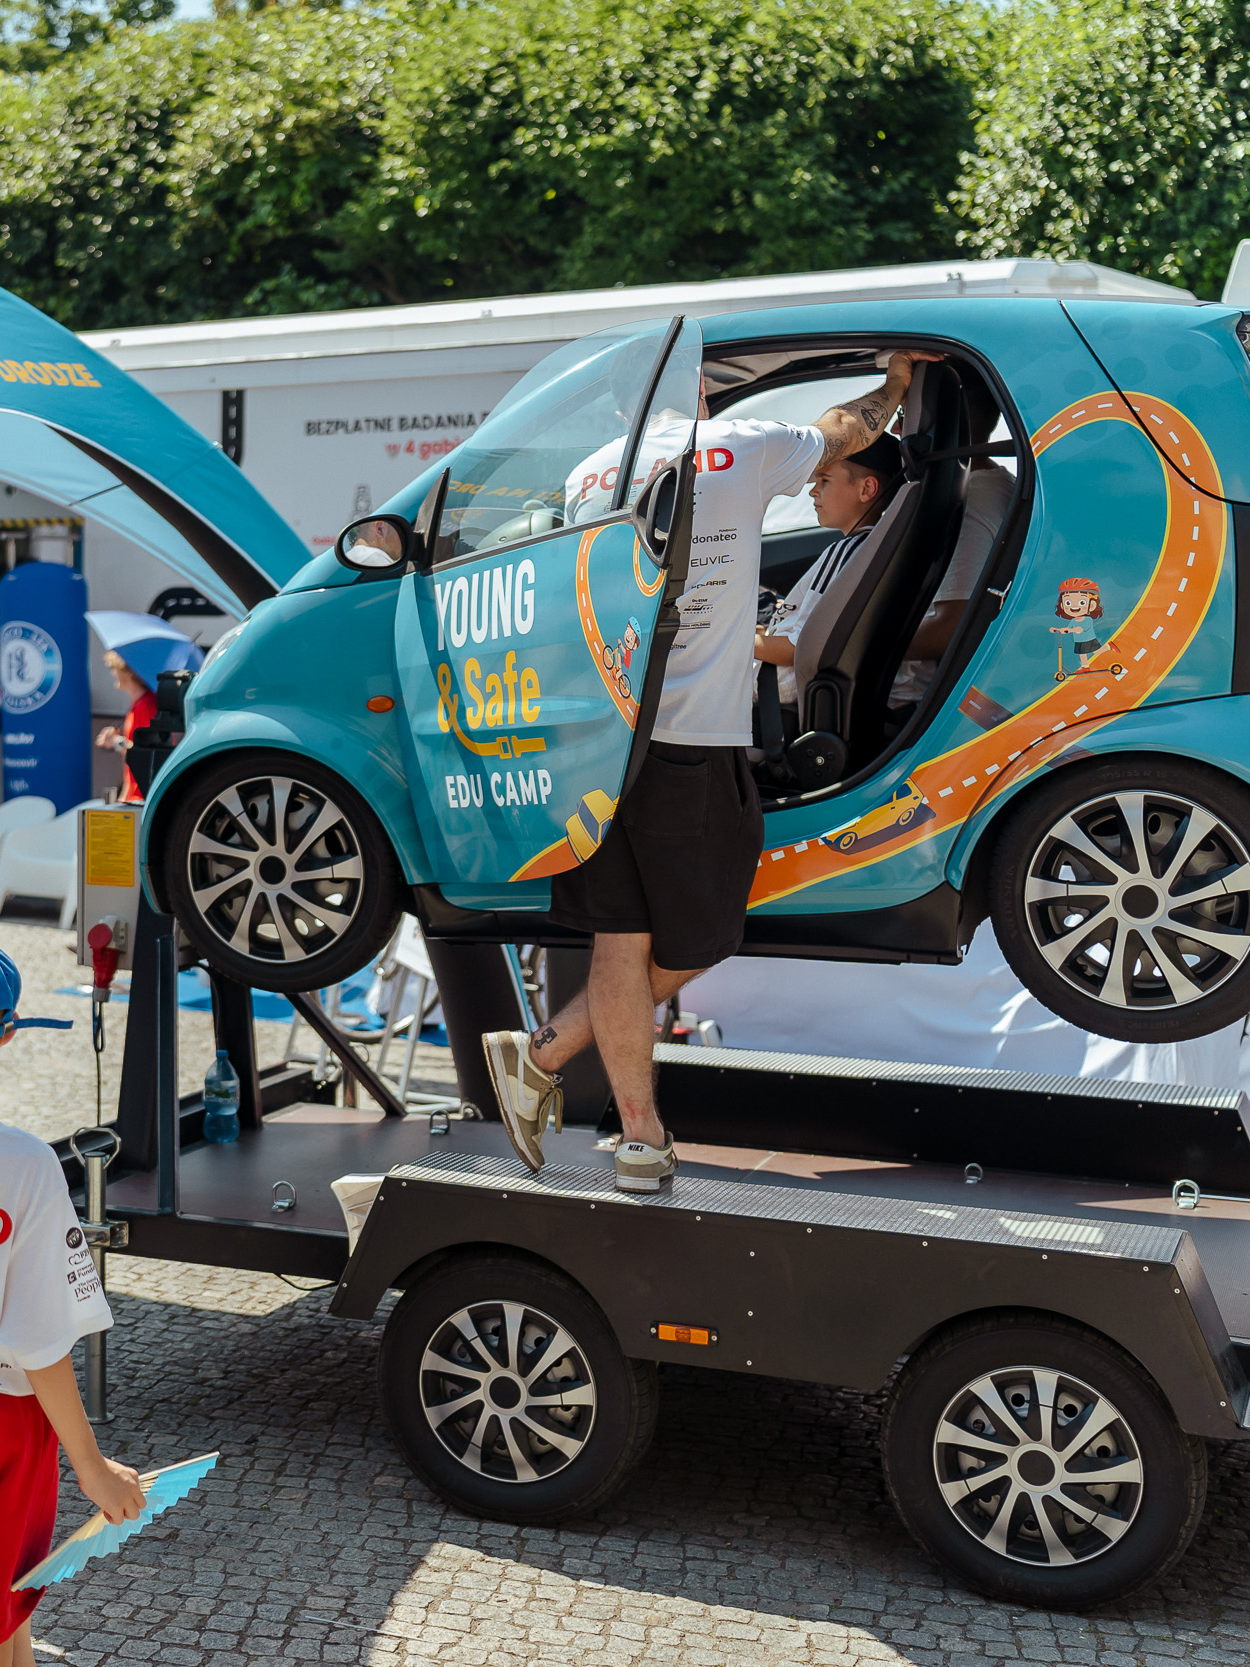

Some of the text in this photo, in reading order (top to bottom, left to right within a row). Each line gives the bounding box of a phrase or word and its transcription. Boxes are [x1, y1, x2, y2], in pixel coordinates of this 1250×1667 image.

[400, 413, 476, 431] BADANIA
[692, 533, 737, 544] donateo
[434, 558, 536, 651] YOUNG
[464, 650, 541, 729] Safe
[445, 768, 552, 808] EDU CAMP
[627, 1144, 645, 1152] NIKE
